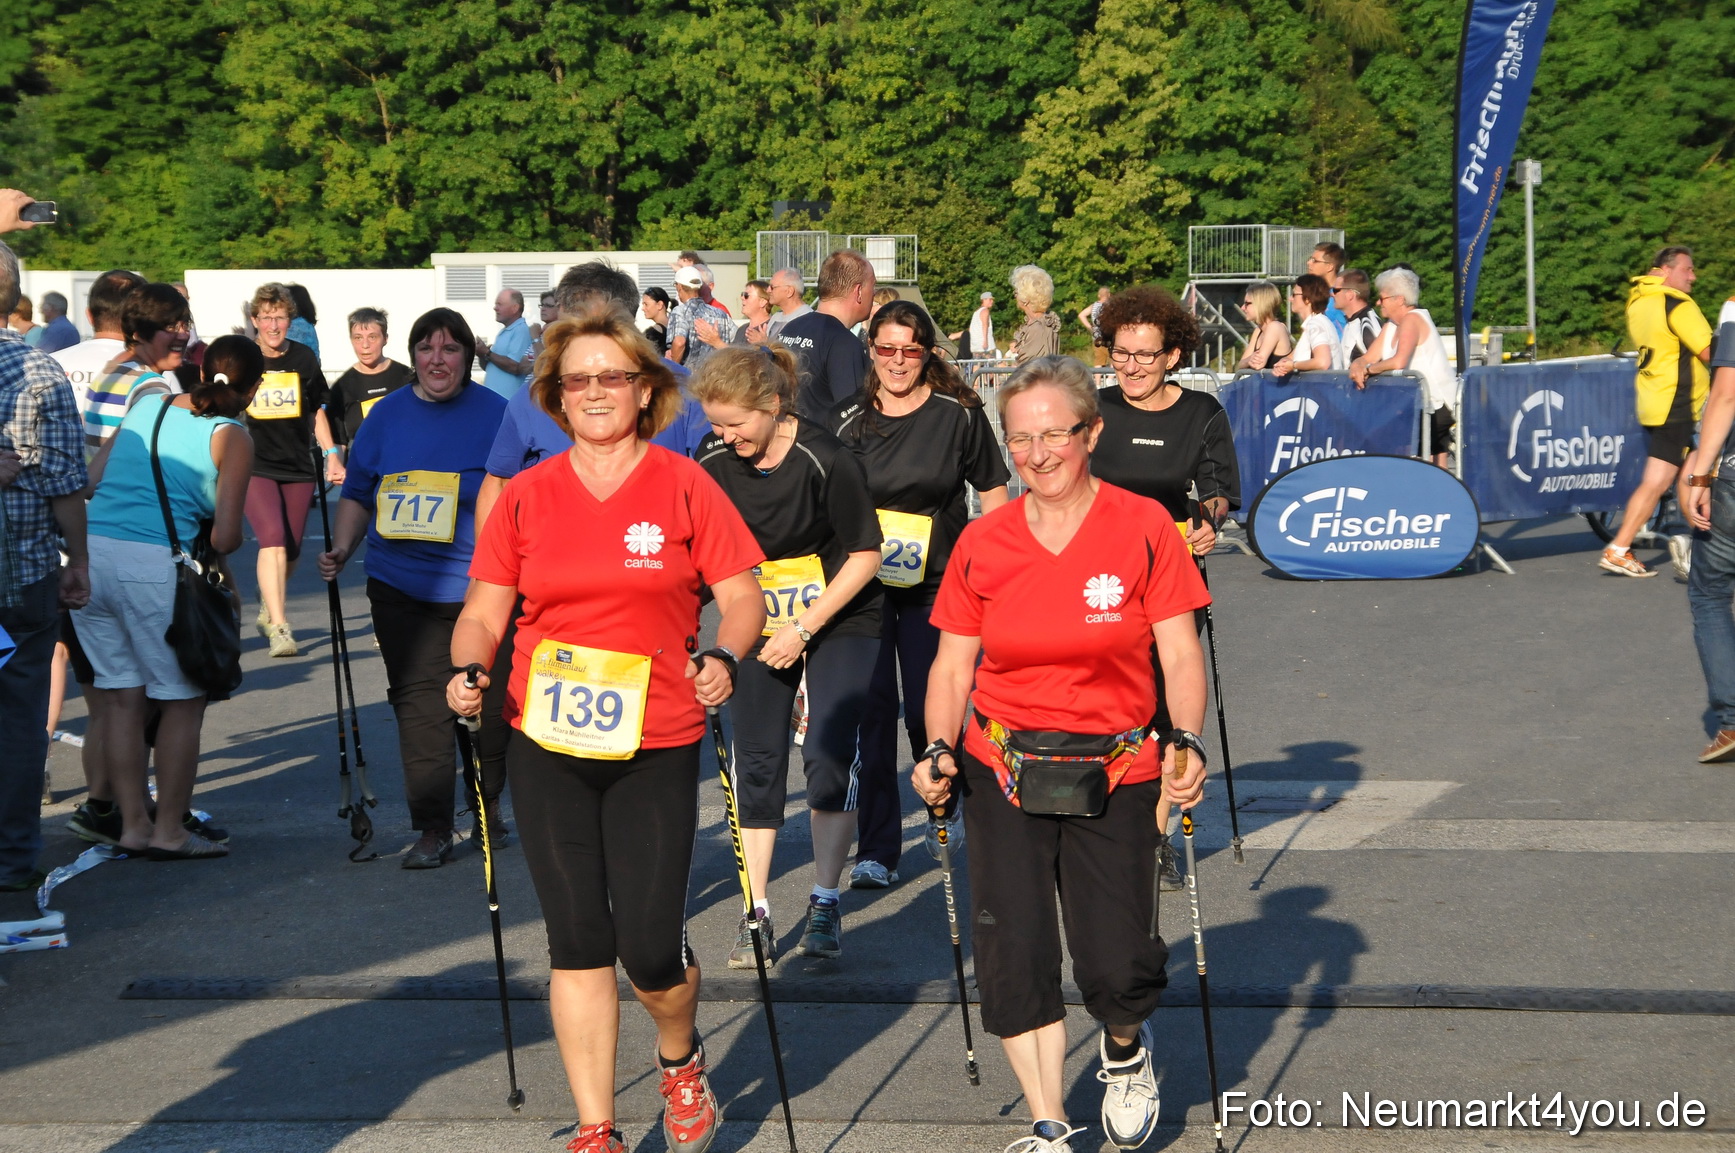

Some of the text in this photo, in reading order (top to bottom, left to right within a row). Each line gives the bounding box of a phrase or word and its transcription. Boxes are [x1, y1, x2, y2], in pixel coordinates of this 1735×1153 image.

[1531, 425, 1625, 469] Fischer
[1538, 472, 1617, 493] AUTOMOBILE
[388, 494, 444, 523] 717
[1310, 509, 1451, 539] Fischer
[1324, 537, 1441, 553] AUTOMOBILE
[624, 557, 664, 570] caritas
[1085, 611, 1123, 624] caritas
[544, 681, 624, 732] 139
